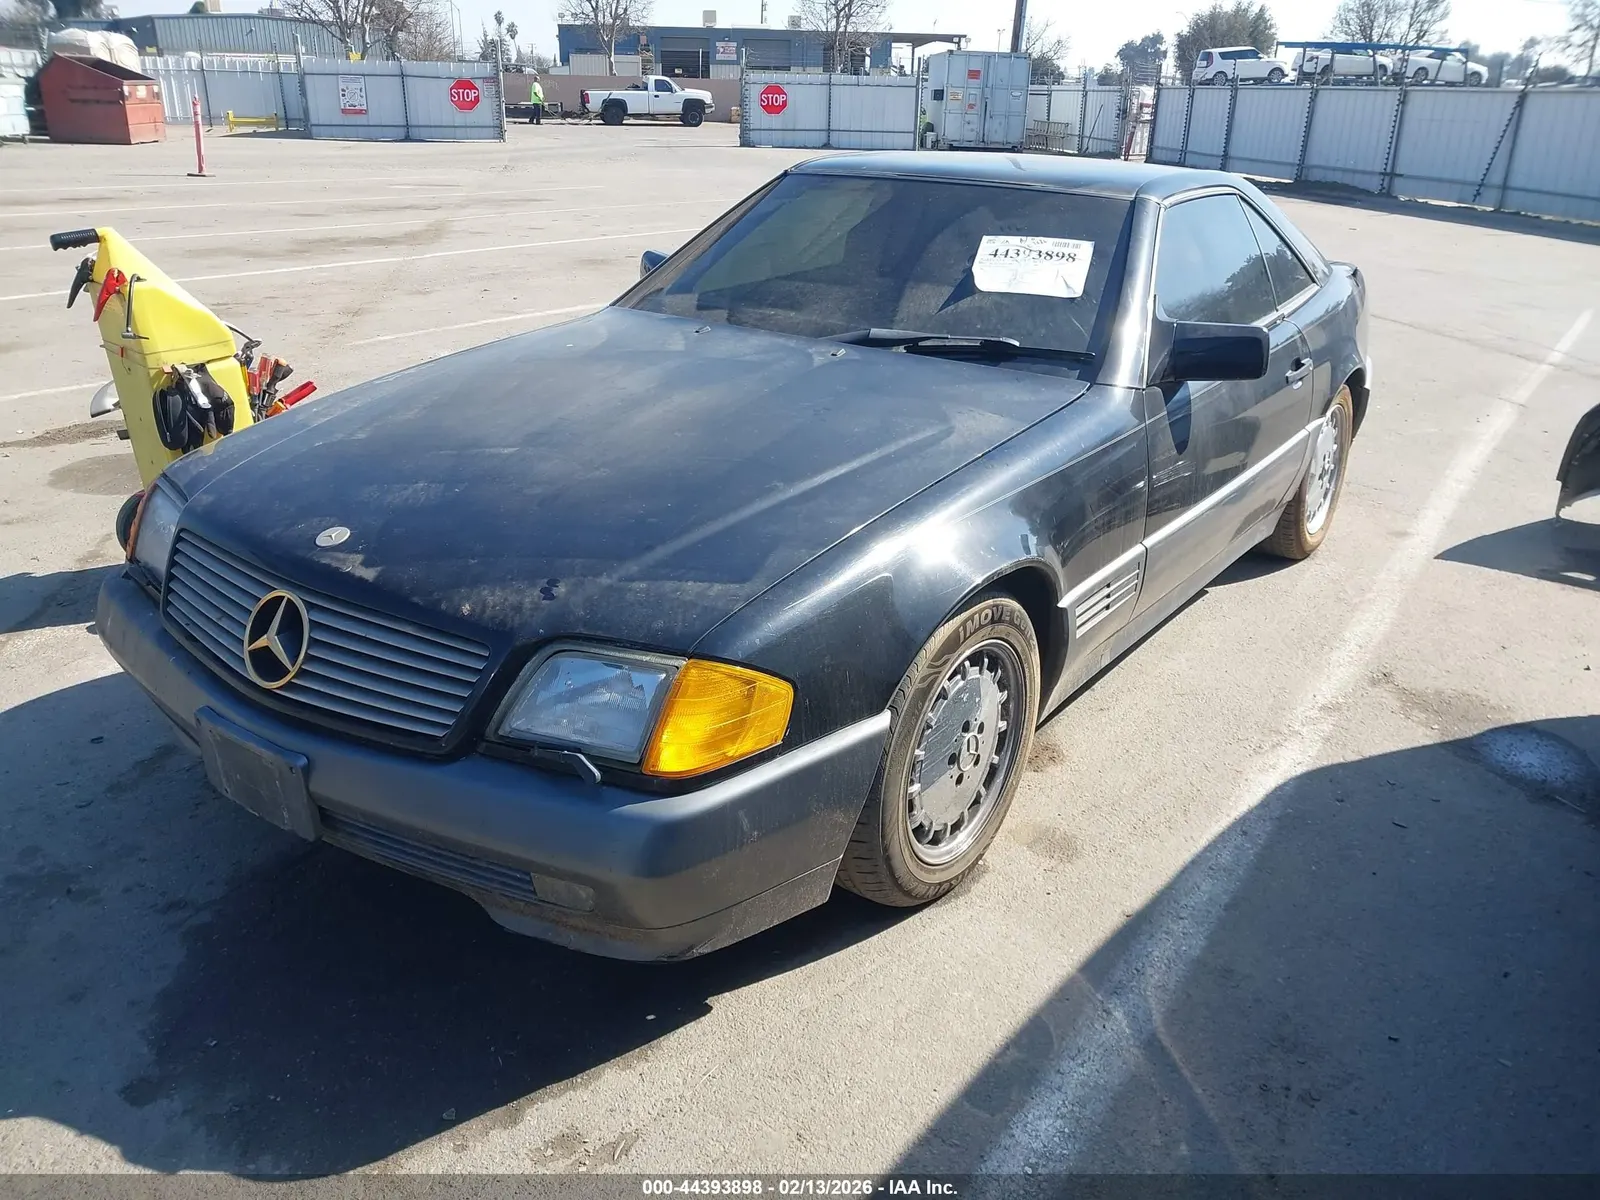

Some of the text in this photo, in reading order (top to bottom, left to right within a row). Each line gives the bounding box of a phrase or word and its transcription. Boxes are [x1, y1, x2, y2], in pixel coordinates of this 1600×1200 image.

[451, 89, 479, 102] STOP
[761, 94, 787, 106] STOP
[988, 247, 1077, 263] 44393898
